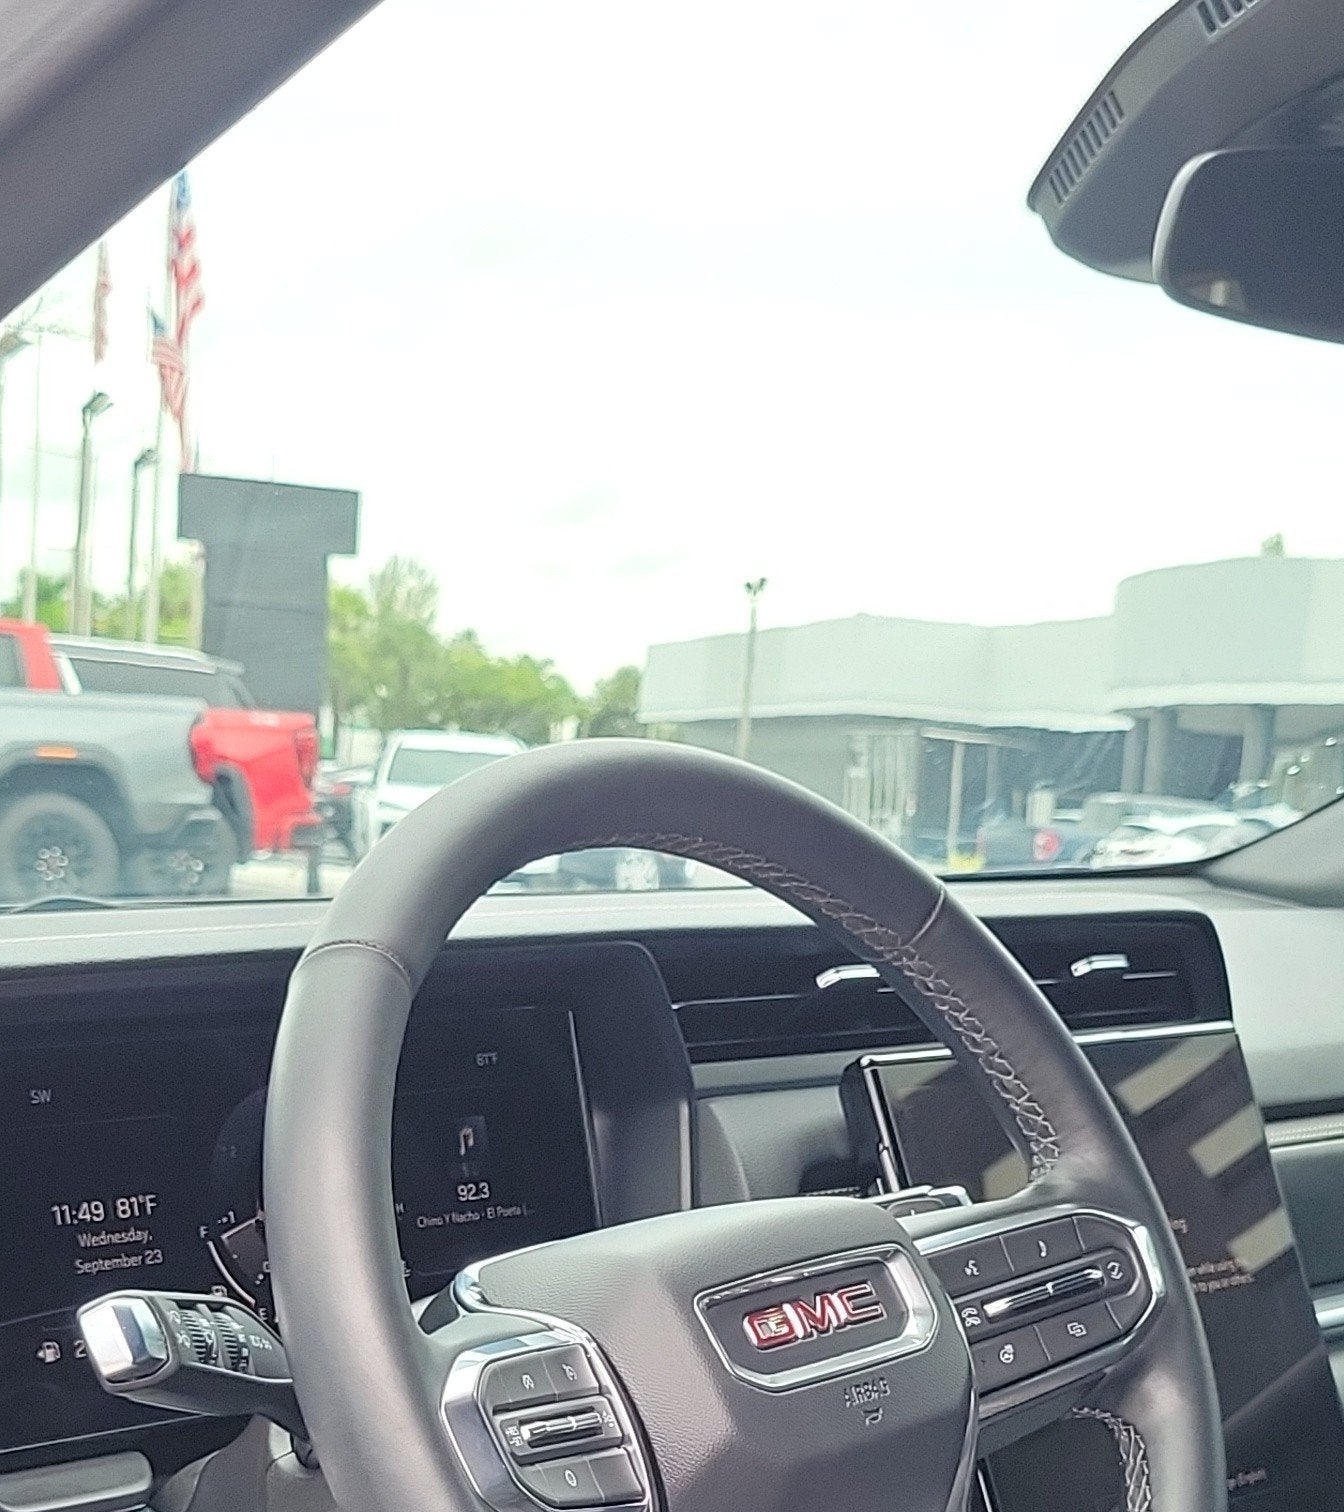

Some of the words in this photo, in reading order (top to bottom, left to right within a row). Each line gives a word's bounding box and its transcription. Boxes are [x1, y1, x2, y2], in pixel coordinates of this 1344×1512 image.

[30, 1089, 53, 1104] SW
[457, 1182, 490, 1202] 92.3
[51, 1201, 105, 1226] 11:49
[116, 1194, 157, 1219] 81°F
[76, 1253, 143, 1275] September
[145, 1250, 164, 1265] 23
[743, 1280, 888, 1353] GMC
